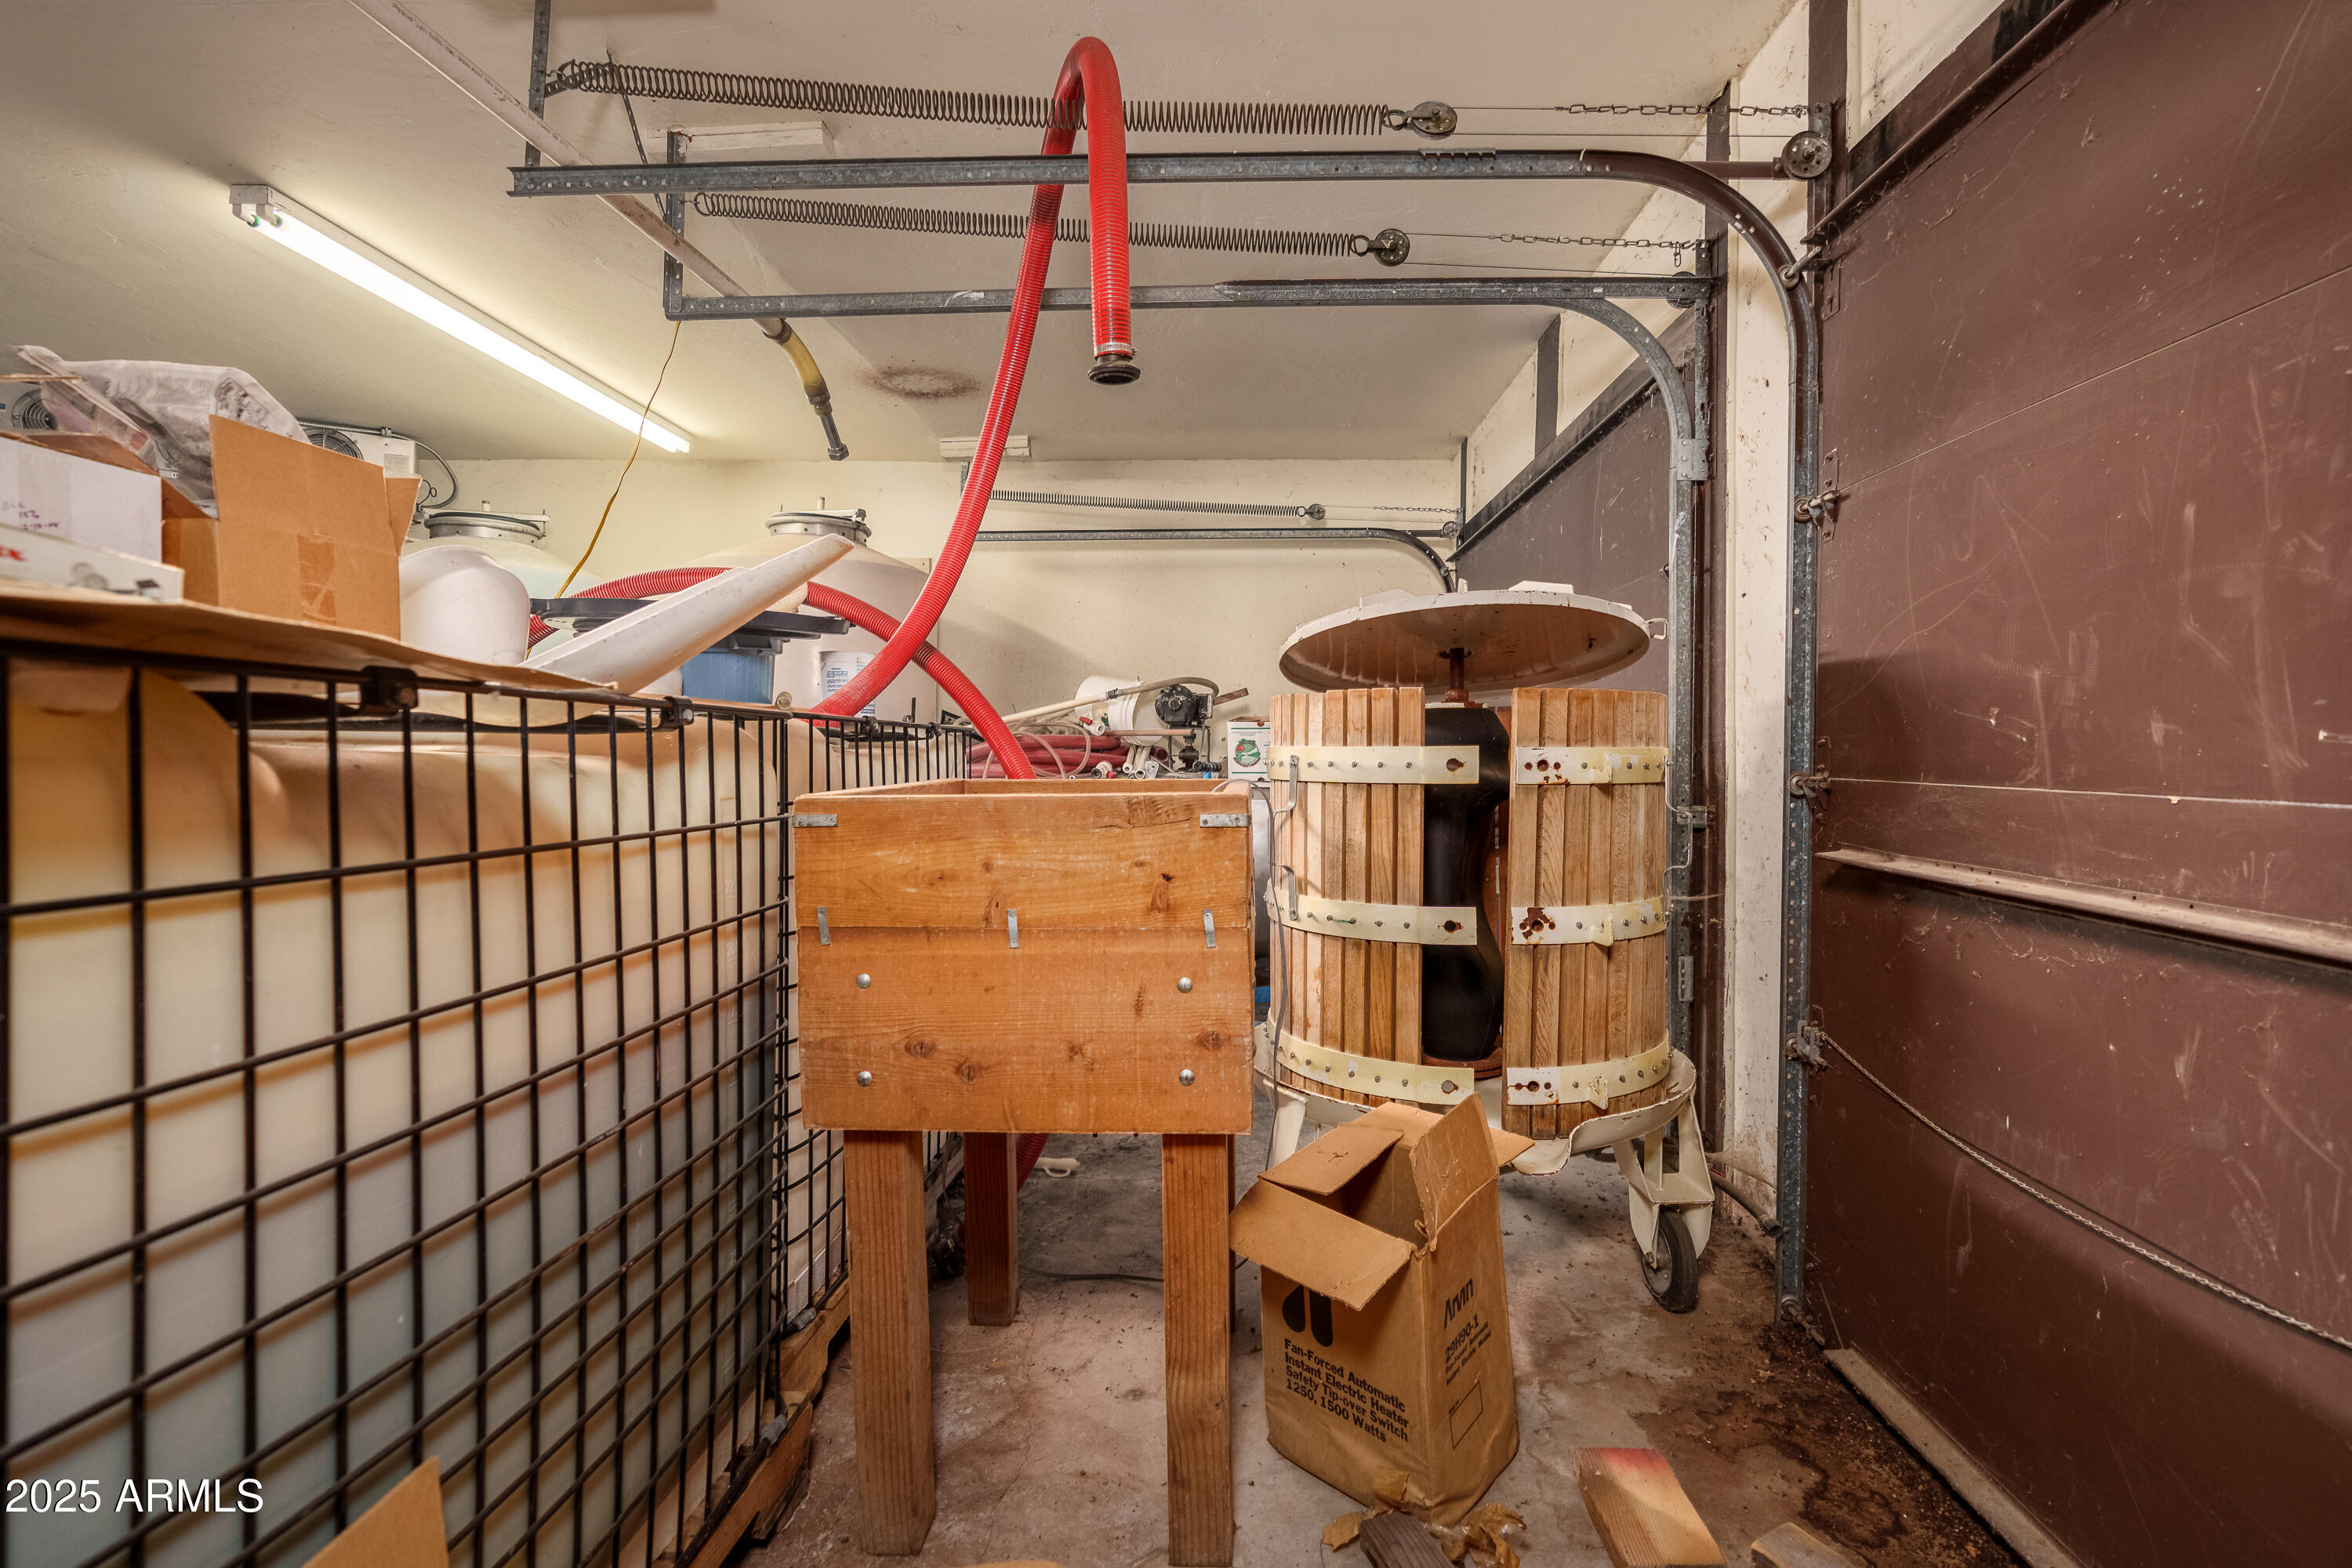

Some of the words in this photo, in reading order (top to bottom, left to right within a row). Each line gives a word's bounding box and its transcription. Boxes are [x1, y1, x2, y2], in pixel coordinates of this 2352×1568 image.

[1284, 1338, 1344, 1377] Fan-Forced
[1348, 1371, 1406, 1413] Automatic
[1445, 1313, 1479, 1363] 29H90-1
[1285, 1352, 1323, 1381] Instant
[1325, 1373, 1367, 1403] Electric
[1370, 1397, 1410, 1428] Heater
[1286, 1365, 1319, 1392] Safety
[1322, 1383, 1367, 1416] Tip-over
[1370, 1410, 1409, 1442] Switch
[1286, 1379, 1317, 1405] 1250,
[1320, 1396, 1349, 1421] 1500
[1352, 1413, 1386, 1443] Watts
